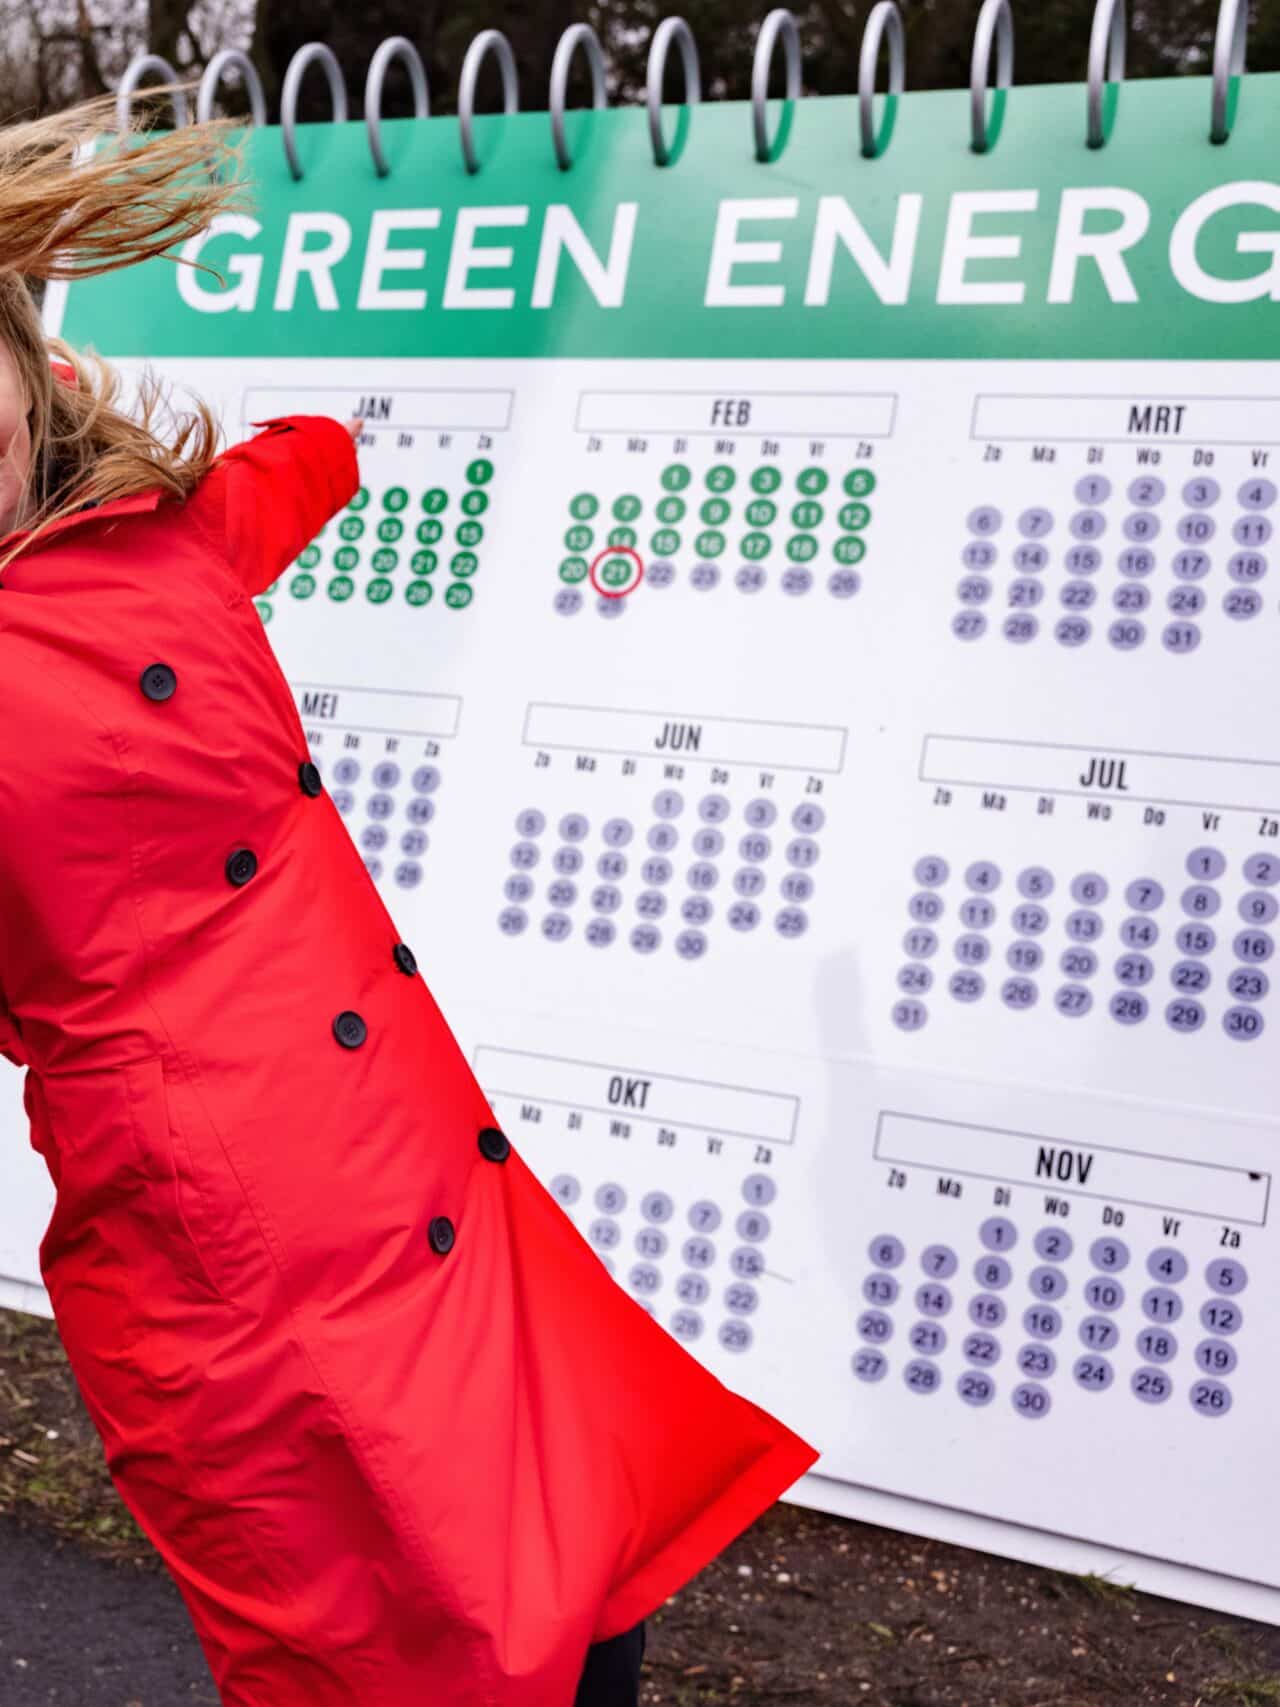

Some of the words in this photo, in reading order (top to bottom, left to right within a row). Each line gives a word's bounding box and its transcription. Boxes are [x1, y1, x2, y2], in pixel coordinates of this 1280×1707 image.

[175, 202, 638, 314] GREEN
[702, 181, 1280, 308] ENERG
[353, 397, 392, 420] JAN
[711, 400, 751, 427] FEB
[1128, 405, 1185, 434] MRT
[1193, 449, 1214, 467] Do
[1252, 450, 1269, 467] Vr
[714, 471, 728, 488] 2
[760, 472, 772, 489] 3
[805, 474, 818, 489] 4
[853, 475, 866, 492] 5
[1138, 483, 1153, 501] 2
[1194, 485, 1208, 502] 3
[1249, 487, 1262, 503] 4
[751, 506, 771, 522] 10
[798, 507, 818, 523] 11
[844, 509, 865, 526] 12
[977, 514, 990, 531] 6
[1030, 515, 1043, 532] 7
[1080, 517, 1094, 534] 8
[1134, 519, 1149, 536] 9
[1186, 522, 1209, 539] 10
[1242, 524, 1264, 540] 11
[421, 525, 438, 539] 14
[745, 539, 766, 554] 17
[414, 555, 433, 571] 21
[605, 563, 626, 580] 21
[969, 548, 991, 565] 13
[1021, 551, 1041, 565] 14
[1073, 552, 1095, 569] 15
[1126, 554, 1149, 571] 16
[1181, 556, 1204, 573] 17
[1237, 559, 1260, 576] 18
[962, 582, 987, 600] 20
[1013, 584, 1036, 602] 21
[1065, 588, 1091, 605] 22
[1118, 590, 1144, 608] 23
[1173, 594, 1198, 610] 24
[1229, 595, 1255, 614] 25
[957, 616, 982, 634] 27
[1007, 620, 1033, 637] 28
[1060, 623, 1086, 640] 29
[1113, 626, 1140, 643] 30
[1168, 629, 1192, 646] 31
[301, 692, 338, 718] MEI
[655, 722, 702, 752] JUN
[1079, 758, 1128, 791] JUL
[707, 801, 720, 818] 2
[754, 805, 766, 823] 3
[801, 812, 813, 826] 4
[982, 792, 1007, 811] Ma
[1087, 803, 1112, 821] Wo
[1144, 806, 1166, 827] Do
[1202, 812, 1220, 831] Vr
[1258, 817, 1279, 837] Za
[613, 825, 624, 841] 7
[745, 840, 766, 858] 10
[792, 845, 812, 862] 11
[603, 859, 621, 874] 14
[739, 874, 760, 890] 17
[1256, 861, 1271, 881] 2
[925, 864, 939, 882] 3
[976, 871, 989, 886] 4
[1029, 875, 1043, 894] 5
[1082, 881, 1096, 900] 6
[1140, 887, 1152, 904] 7
[1193, 893, 1208, 911] 8
[1252, 900, 1266, 918] 9
[594, 890, 616, 907] 21
[639, 896, 662, 914] 22
[685, 903, 708, 920] 23
[731, 907, 754, 924] 24
[779, 913, 803, 931] 25
[544, 919, 567, 936] 27
[680, 936, 704, 955] 30
[916, 900, 938, 918] 10
[968, 906, 989, 923] 11
[1020, 912, 1043, 930] 12
[1074, 918, 1096, 937] 13
[1129, 925, 1151, 942] 14
[1184, 931, 1209, 950] 15
[1242, 938, 1266, 957] 16
[911, 935, 933, 952] 17
[962, 942, 984, 960] 18
[1014, 948, 1038, 967] 19
[1065, 954, 1092, 974] 20
[1121, 961, 1146, 980] 21
[1177, 968, 1204, 988] 22
[1235, 976, 1262, 995] 23
[898, 1006, 920, 1024] 31
[902, 970, 927, 987] 24
[953, 976, 979, 995] 25
[1006, 983, 1032, 1003] 26
[1060, 990, 1087, 1008] 27
[1115, 998, 1142, 1018] 28
[1172, 1005, 1199, 1025] 29
[1230, 1013, 1258, 1033] 30
[608, 1076, 651, 1109] OKT
[1036, 1147, 1093, 1184] NOV
[700, 1209, 712, 1225] 7
[937, 1177, 962, 1198] Ma
[993, 1187, 1011, 1207] Di
[1045, 1196, 1070, 1218] Wo
[1102, 1206, 1125, 1228] Do
[1163, 1216, 1181, 1237] Vr
[1220, 1227, 1241, 1248] Za
[595, 1226, 616, 1245] 12
[689, 1245, 708, 1263] 14
[1045, 1236, 1061, 1256] 2
[1103, 1246, 1116, 1266] 3
[1160, 1258, 1173, 1275] 4
[1219, 1268, 1233, 1287] 5
[680, 1279, 703, 1298] 21
[879, 1244, 893, 1262] 6
[934, 1254, 946, 1272] 7
[985, 1264, 999, 1283] 8
[1041, 1275, 1055, 1294] 9
[1092, 1285, 1117, 1306] 10
[1151, 1297, 1174, 1317] 11
[1208, 1308, 1234, 1329] 12
[870, 1280, 892, 1300] 13
[923, 1291, 944, 1310] 14
[976, 1302, 999, 1322] 15
[1031, 1313, 1053, 1333] 16
[1087, 1324, 1112, 1343] 17
[1144, 1336, 1168, 1356] 18
[1204, 1347, 1229, 1368] 19
[862, 1316, 888, 1338] 20
[914, 1327, 938, 1347] 21
[967, 1339, 995, 1360] 22
[1023, 1350, 1049, 1371] 23
[1079, 1362, 1105, 1382] 24
[1137, 1374, 1165, 1395] 25
[1196, 1387, 1224, 1408] 26
[857, 1355, 883, 1375] 27
[909, 1366, 935, 1387] 28
[962, 1378, 990, 1399] 29
[1018, 1390, 1045, 1411] 30
